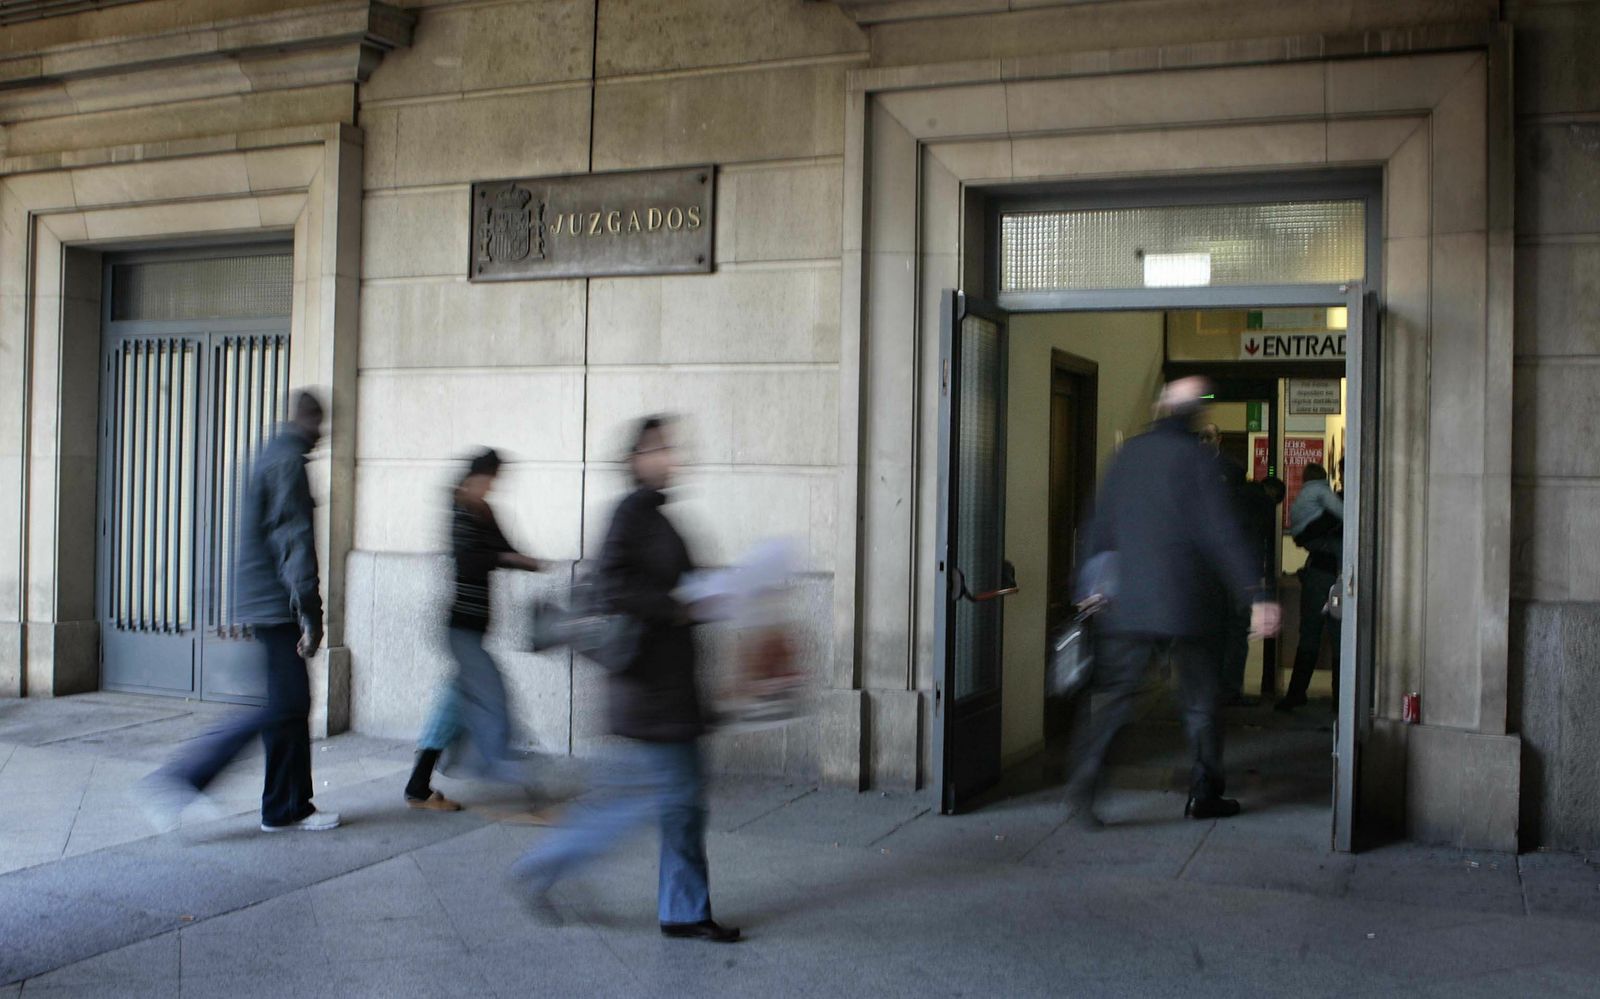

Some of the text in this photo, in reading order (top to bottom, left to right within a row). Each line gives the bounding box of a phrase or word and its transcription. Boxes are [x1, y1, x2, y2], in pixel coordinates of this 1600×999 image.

[550, 206, 701, 235] JUZGADOS
[1263, 335, 1346, 355] ENTRAD
[1285, 440, 1306, 448] ECHOS
[1285, 448, 1322, 457] IUDADANOS
